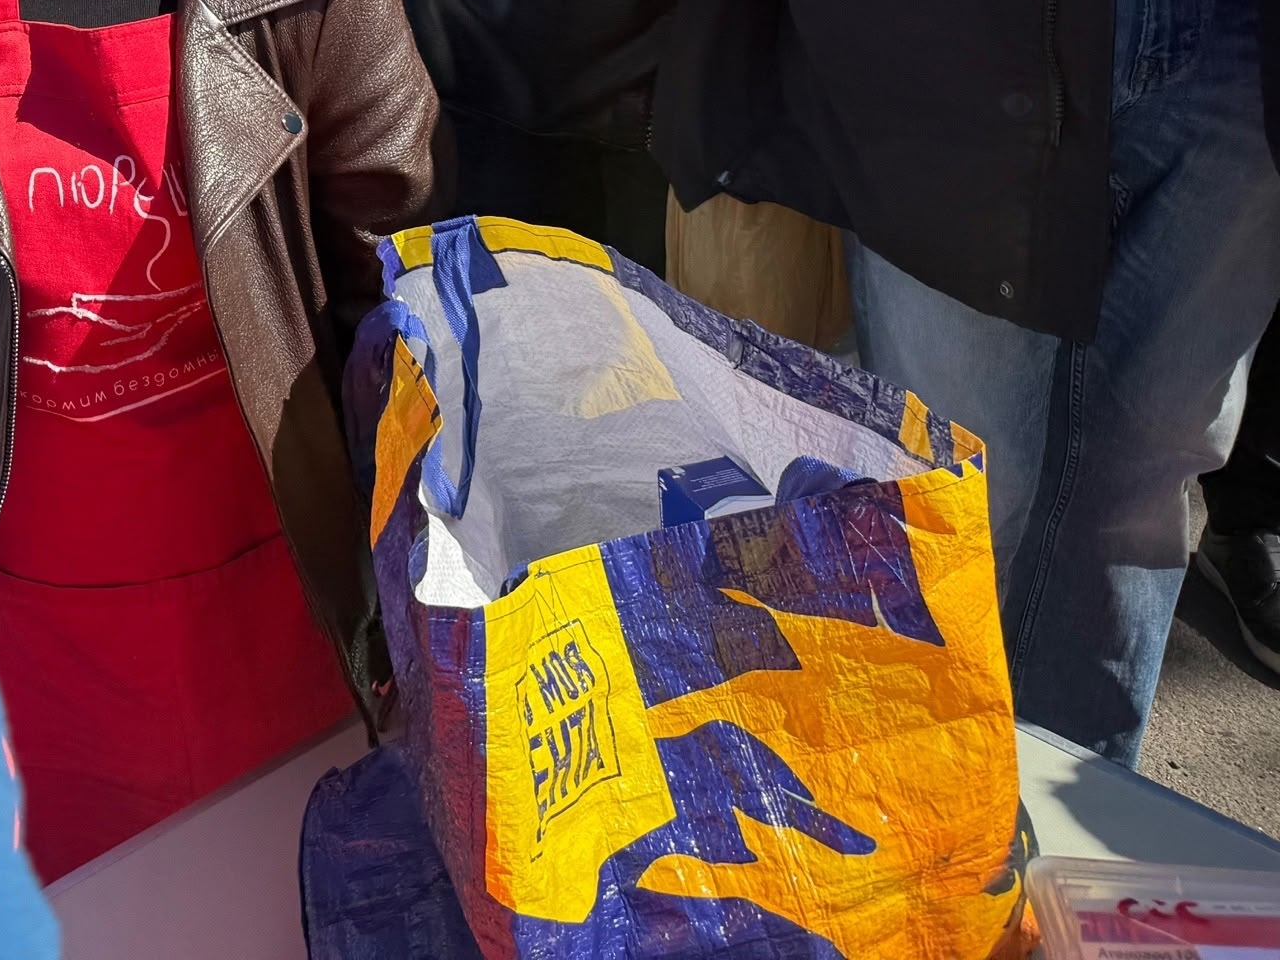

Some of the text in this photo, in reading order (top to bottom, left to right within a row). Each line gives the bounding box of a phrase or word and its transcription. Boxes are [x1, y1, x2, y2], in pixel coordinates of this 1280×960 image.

[113, 348, 218, 396] бездомны
[529, 640, 596, 714] МОЯ
[528, 698, 605, 843] ЕНТА
